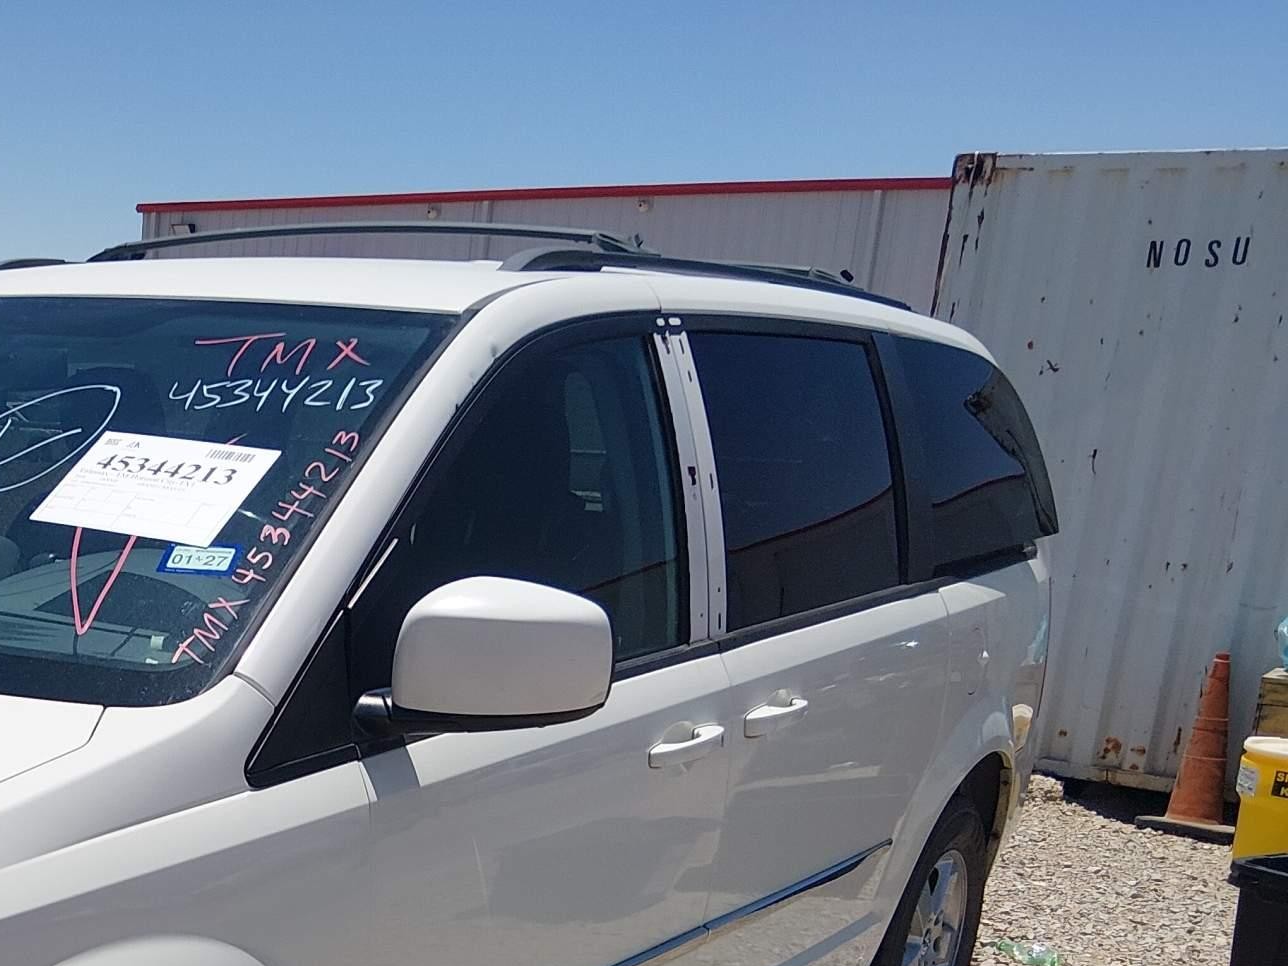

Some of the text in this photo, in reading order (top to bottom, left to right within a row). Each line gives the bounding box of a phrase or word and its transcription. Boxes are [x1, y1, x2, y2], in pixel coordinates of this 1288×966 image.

[1146, 236, 1251, 268] NOSU
[194, 332, 372, 378] TMX
[168, 375, 384, 413] 45344213
[96, 453, 238, 486] 45344213
[171, 596, 251, 664] TMX
[231, 430, 360, 585] 45344213
